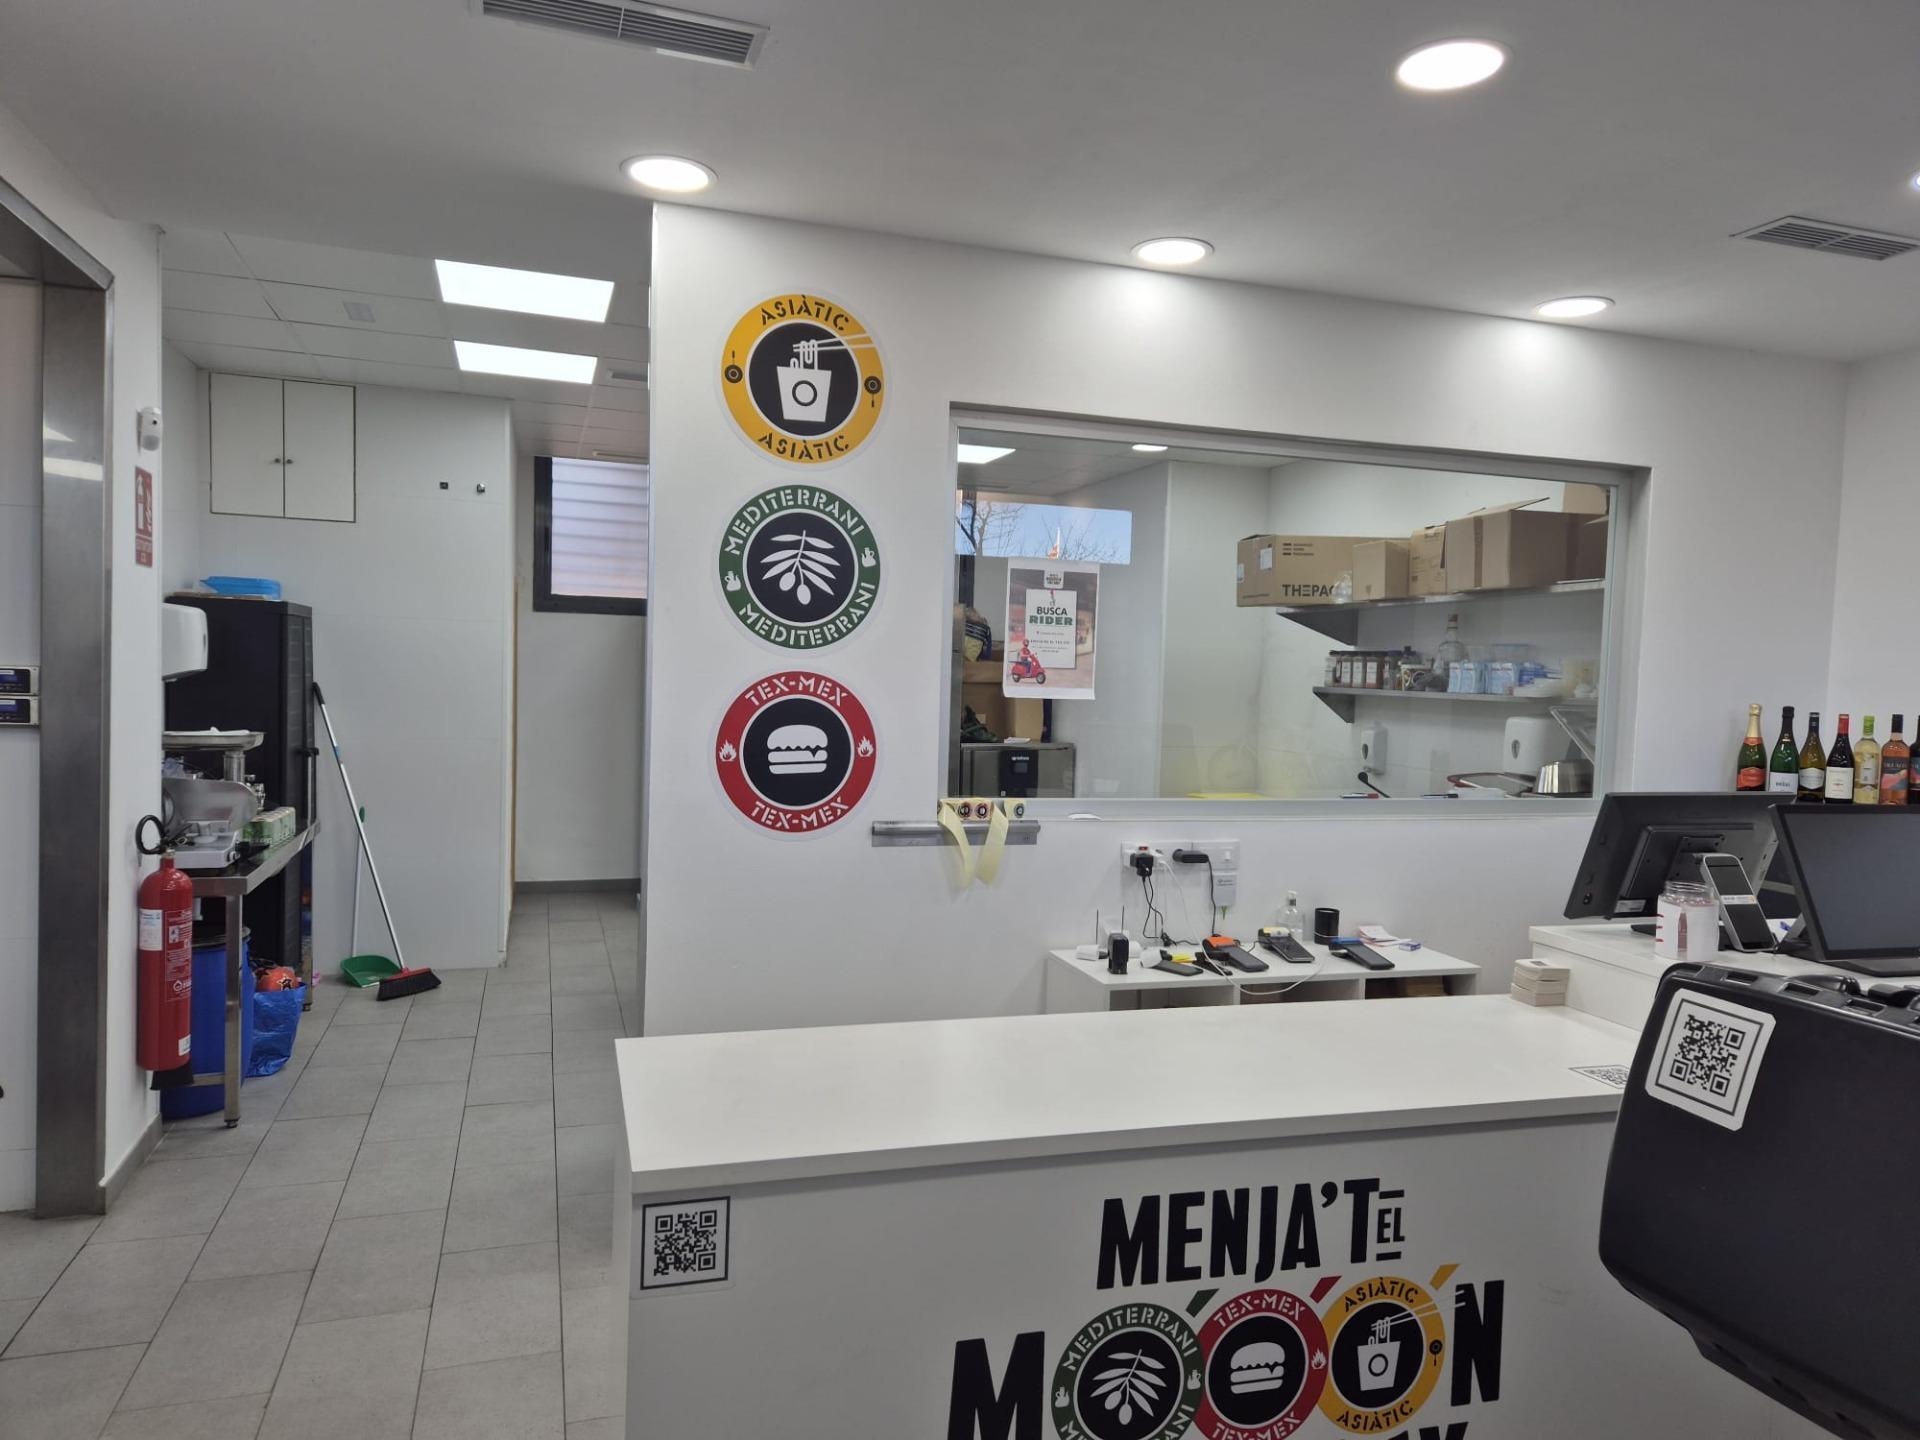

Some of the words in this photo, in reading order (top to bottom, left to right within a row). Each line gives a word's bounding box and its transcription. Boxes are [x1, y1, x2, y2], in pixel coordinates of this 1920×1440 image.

[760, 294, 849, 331] ASIÀTIC
[758, 432, 849, 460] ASIÀTIC
[724, 488, 865, 556] MEDITERRANI
[738, 582, 876, 646] MEDITERRANI
[1029, 615, 1073, 626] RIDER
[1036, 606, 1068, 616] BUSCA
[744, 674, 849, 708] TEX-MEX
[749, 796, 850, 830] TEX-MEX
[1096, 1177, 1380, 1290] MENJA'T
[1376, 1207, 1405, 1244] EL
[1213, 1292, 1306, 1328] TEX-MEX
[1344, 1276, 1419, 1313] ASIÀTIC
[1062, 1307, 1198, 1371] MEDITERRANI
[1336, 1400, 1414, 1431] ASIÀTIC
